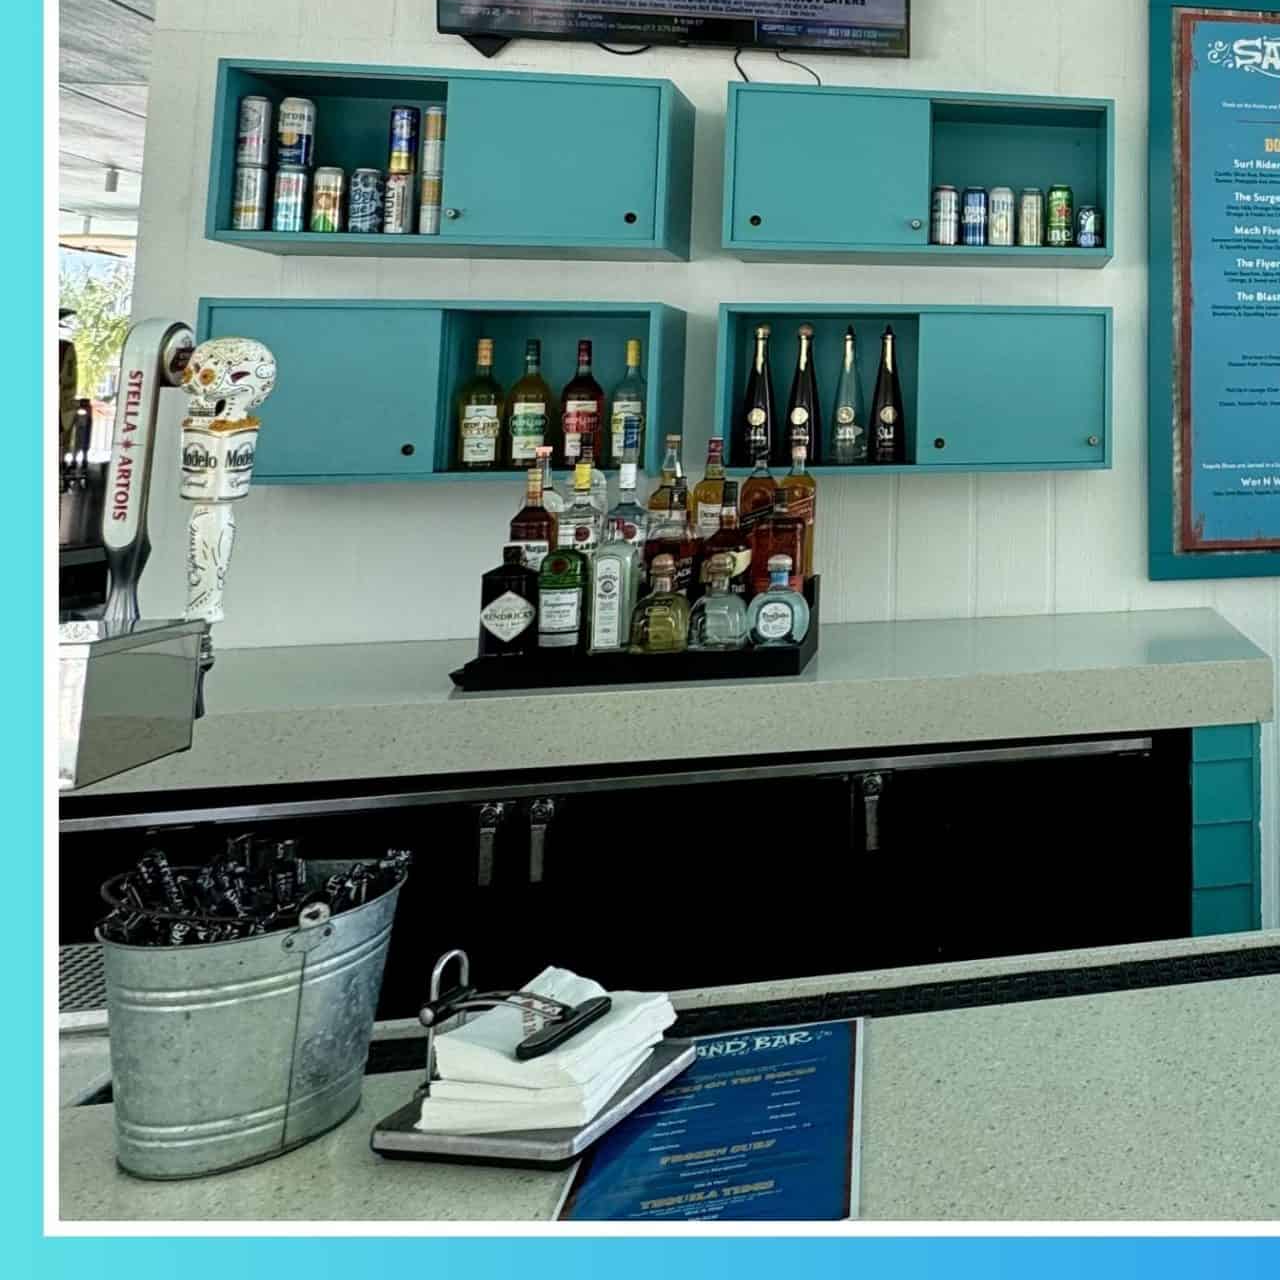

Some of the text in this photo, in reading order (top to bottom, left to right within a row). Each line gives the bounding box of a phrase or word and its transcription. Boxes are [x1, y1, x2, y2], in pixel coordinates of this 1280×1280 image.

[1233, 159, 1280, 169] Surf Rider
[1234, 192, 1251, 202] The
[384, 185, 397, 225] TRULY
[1234, 225, 1261, 235] Mach
[1236, 258, 1280, 270] The Flyer
[1236, 292, 1280, 302] The Blast
[113, 370, 144, 521] STELLA ARTOIS
[752, 1031, 812, 1051] BAR
